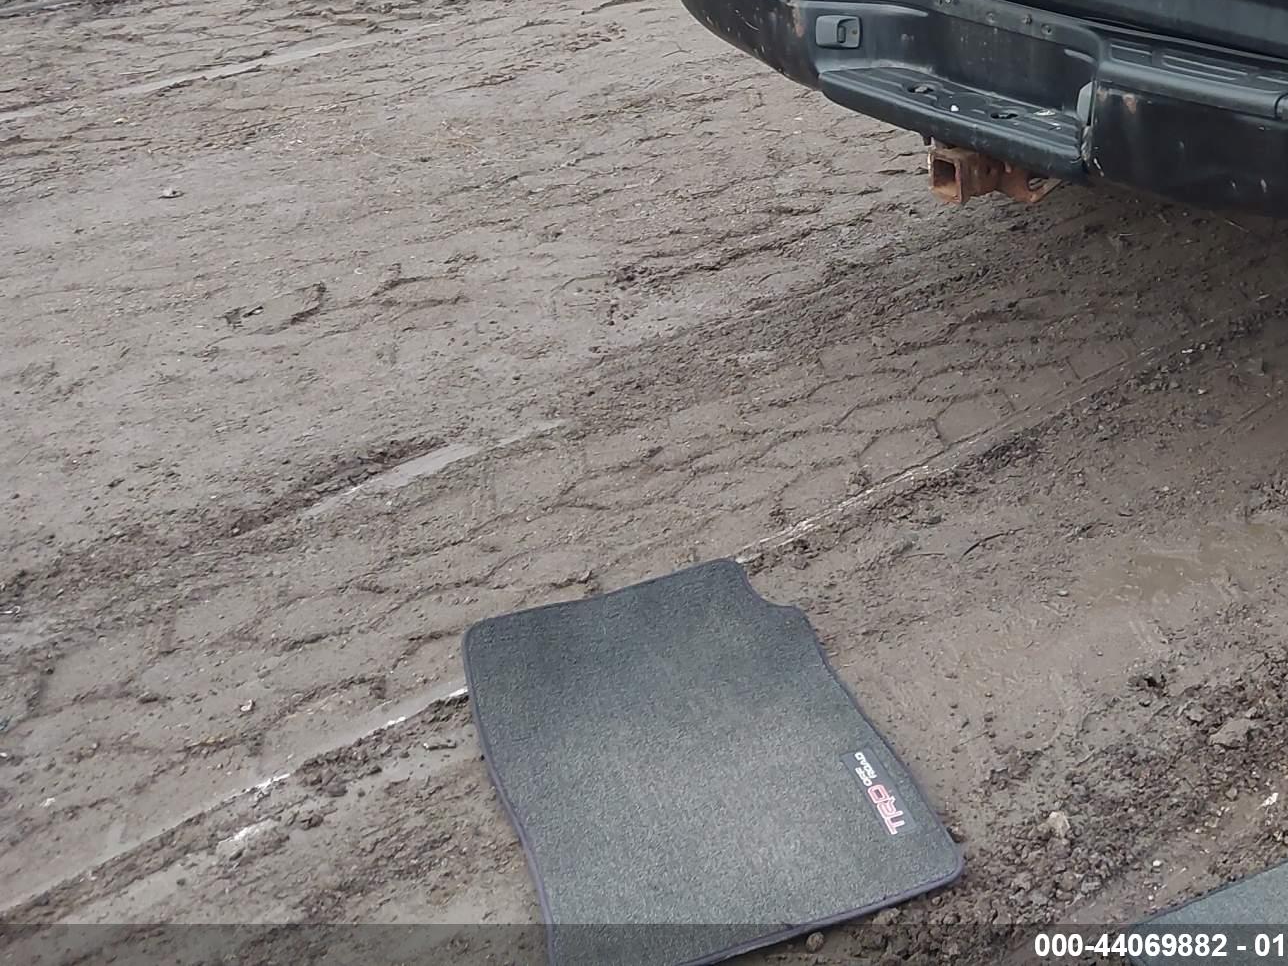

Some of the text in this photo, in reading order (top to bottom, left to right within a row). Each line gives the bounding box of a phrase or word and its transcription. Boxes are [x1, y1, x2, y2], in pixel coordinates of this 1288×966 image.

[854, 765, 873, 787] OFF
[855, 751, 878, 780] ROAD
[867, 784, 906, 835] TRD
